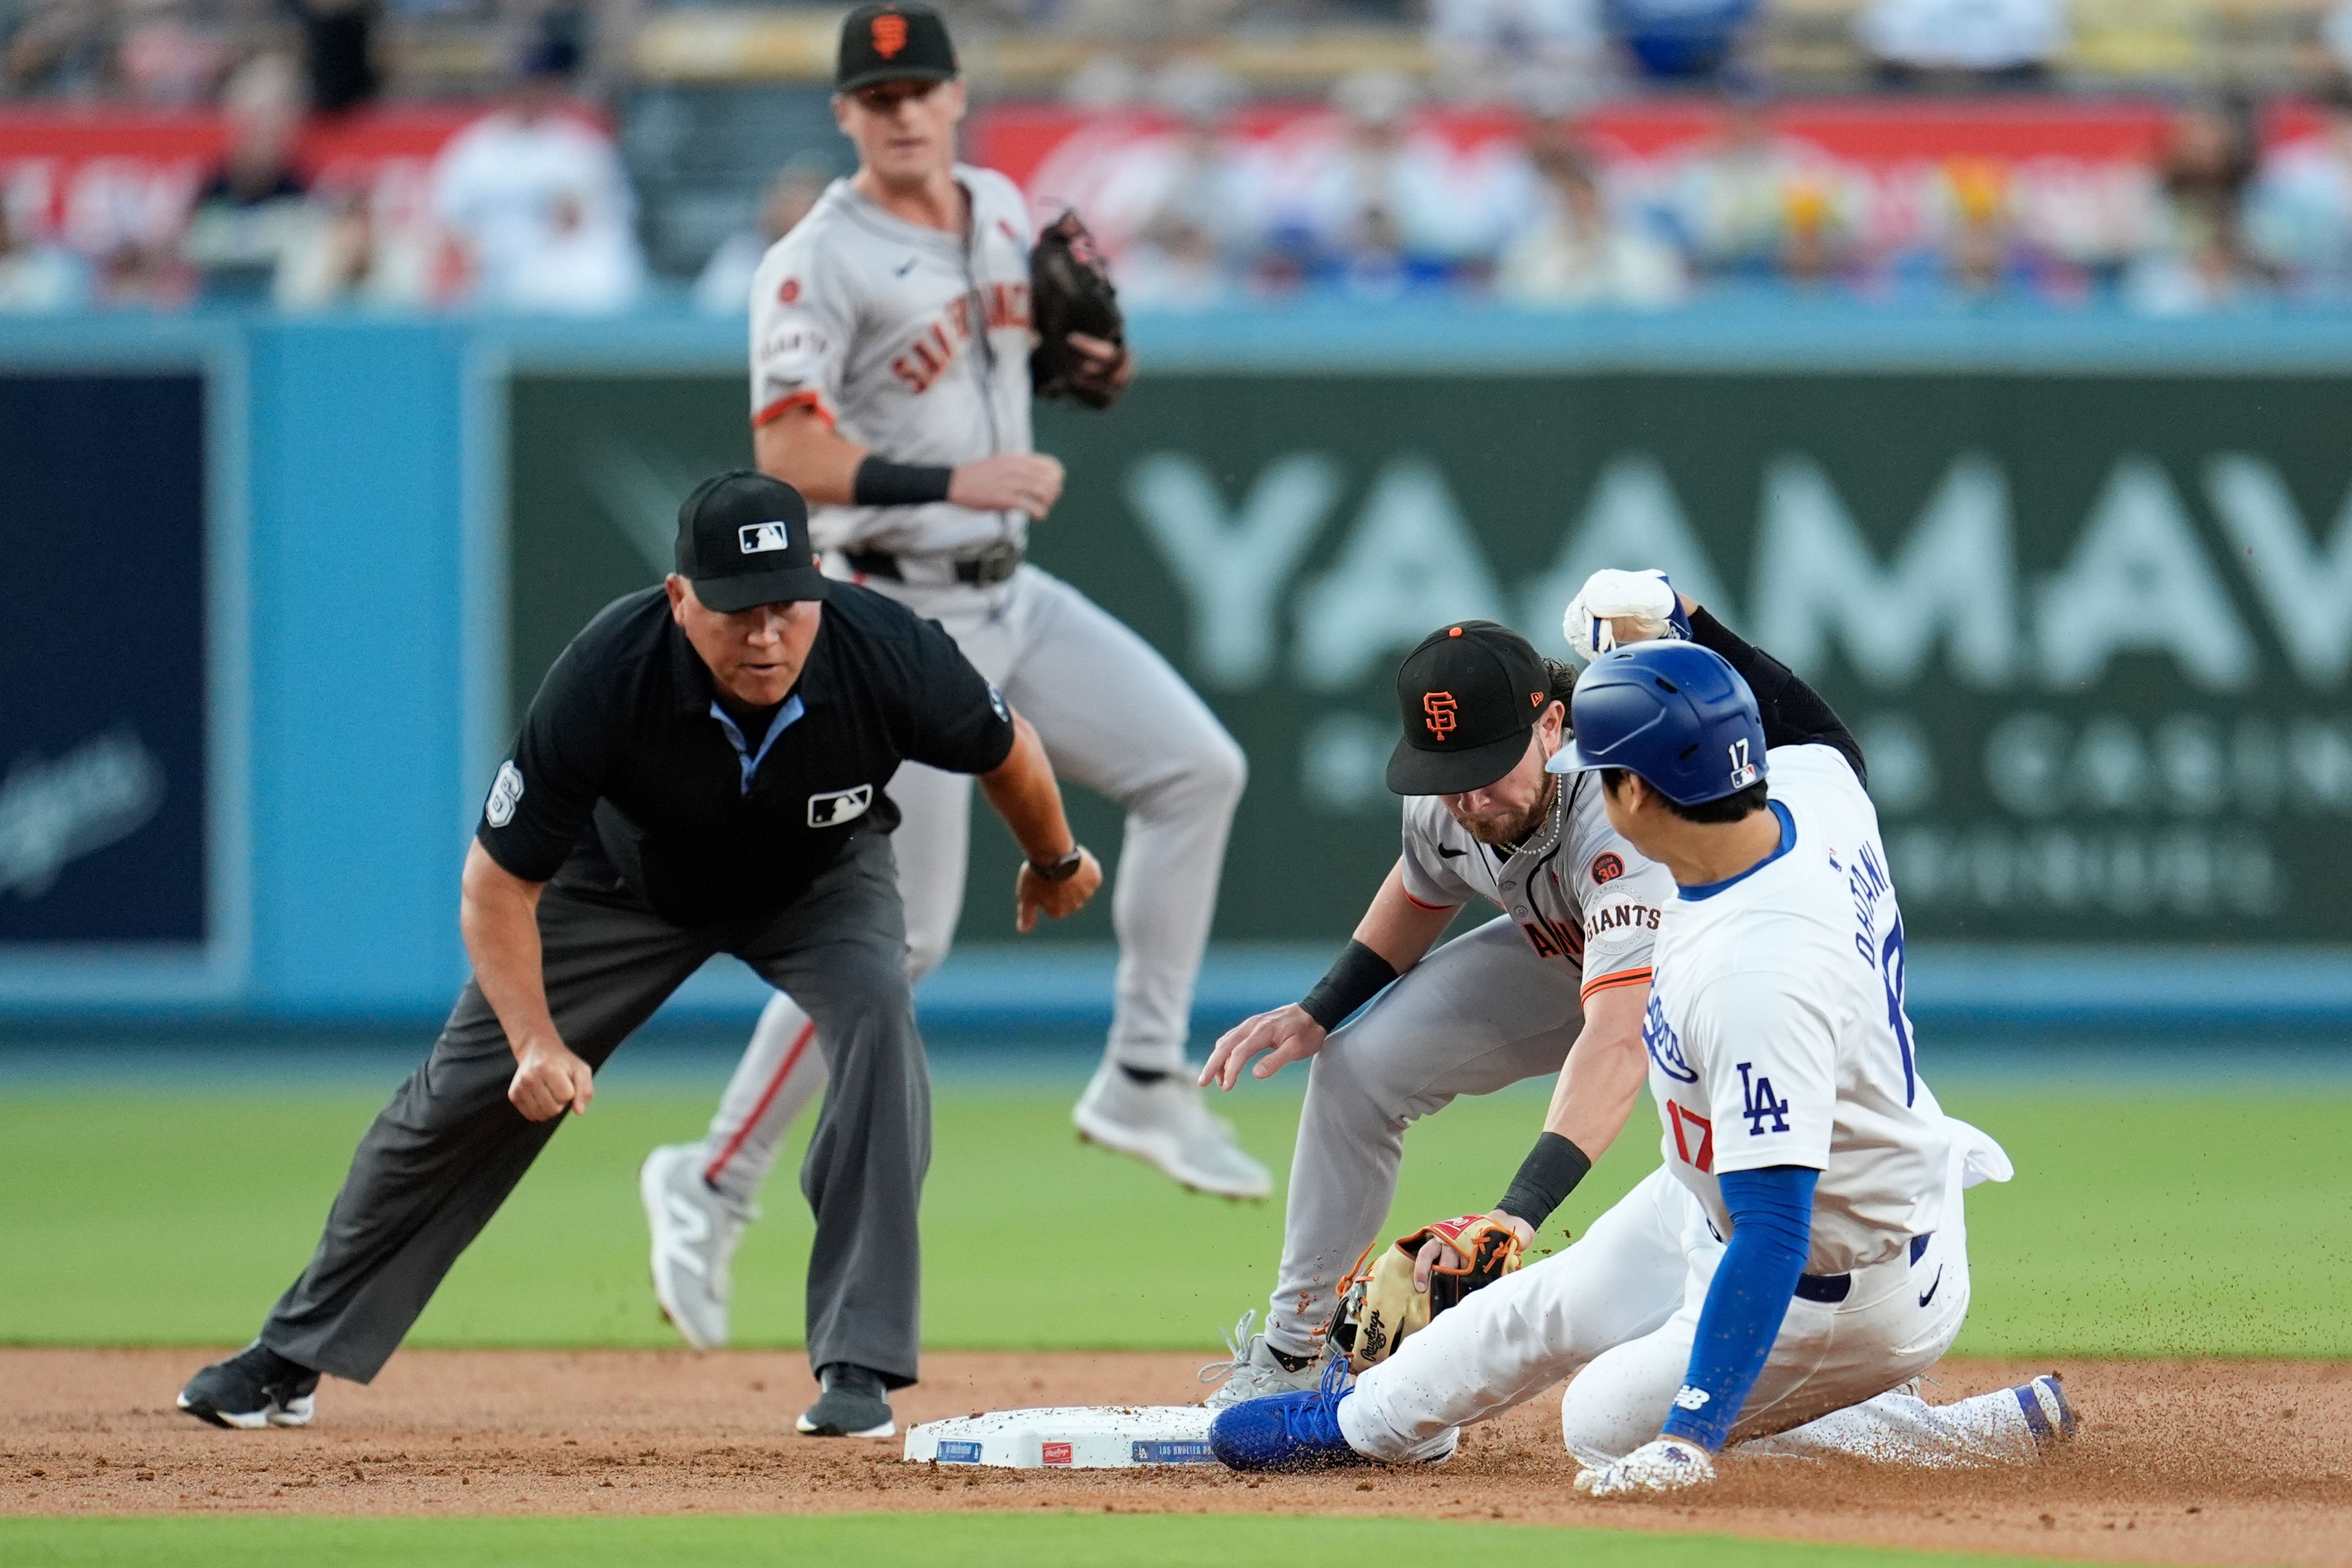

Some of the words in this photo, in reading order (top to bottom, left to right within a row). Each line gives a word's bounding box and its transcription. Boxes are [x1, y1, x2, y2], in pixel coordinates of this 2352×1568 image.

[1728, 737, 1749, 771] 17
[486, 759, 525, 828] 6
[1597, 862, 1620, 883] 30
[1586, 905, 1662, 943] GIANTS
[1849, 840, 1889, 971] OHTANI
[1736, 1061, 1790, 1137] LA
[1667, 1098, 1714, 1174] 17
[1159, 1446, 1171, 1456] LOS
